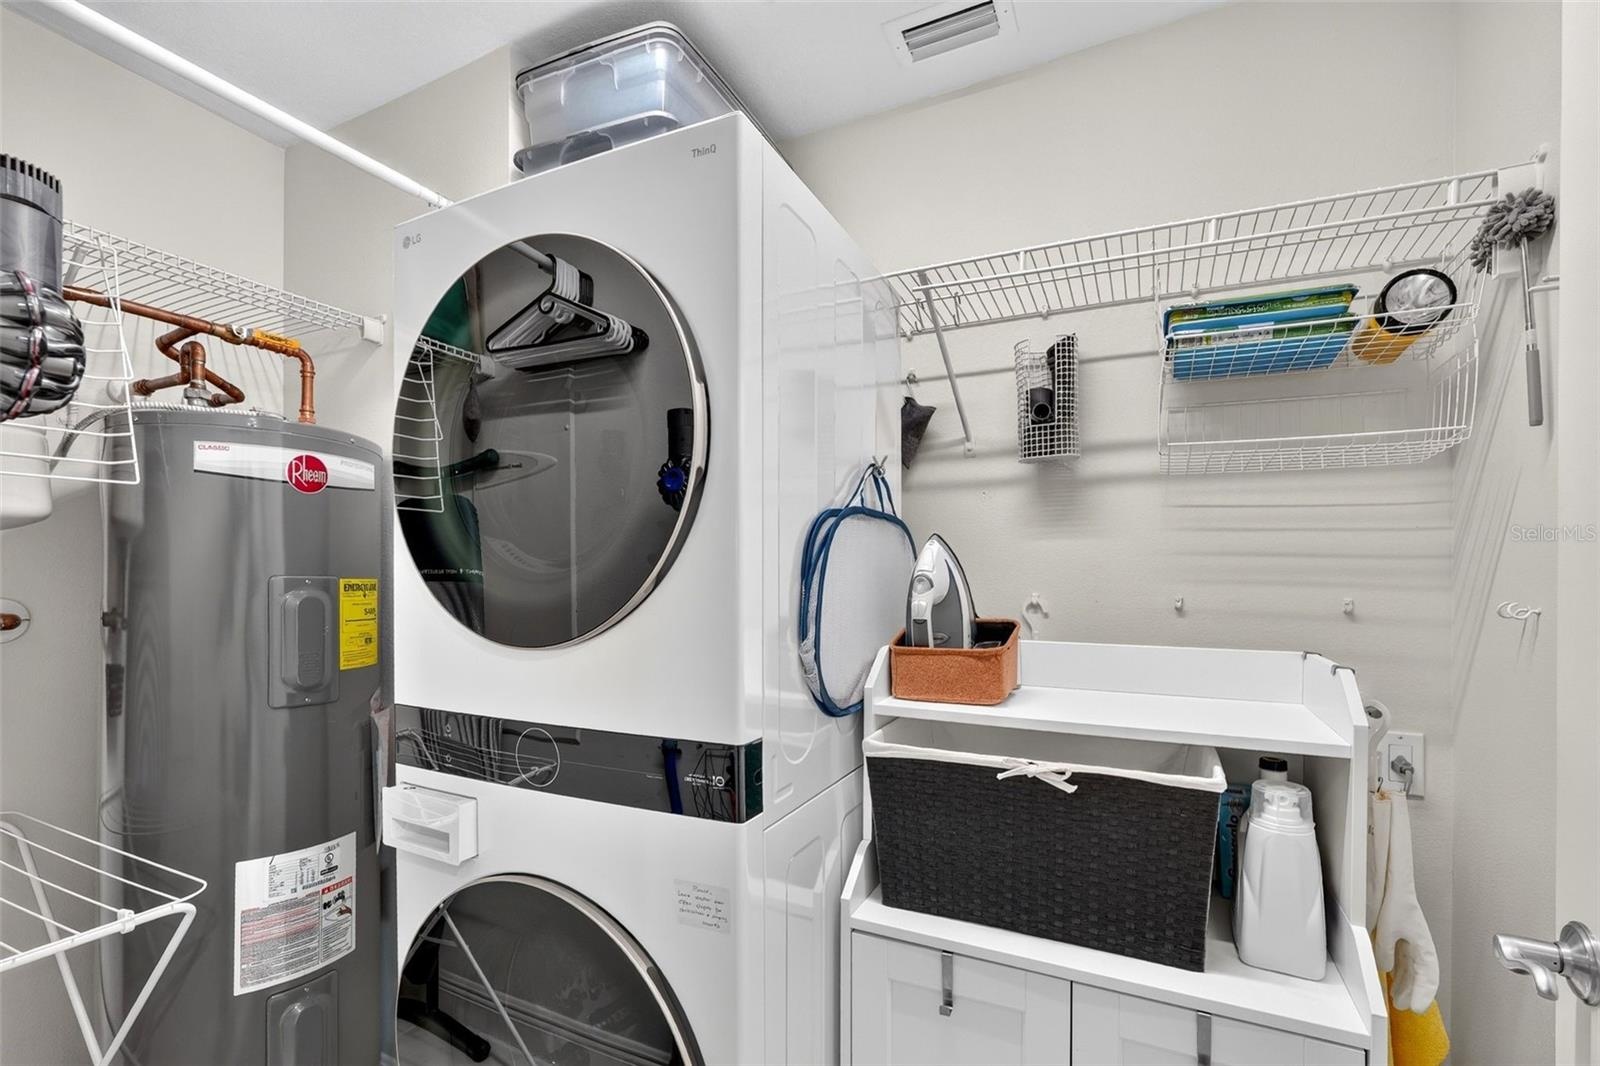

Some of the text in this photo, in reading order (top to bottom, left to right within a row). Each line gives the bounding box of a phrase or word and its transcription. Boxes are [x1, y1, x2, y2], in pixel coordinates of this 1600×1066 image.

[691, 144, 716, 158] ThinQ
[411, 233, 423, 245] LG
[292, 455, 326, 486] Rheem
